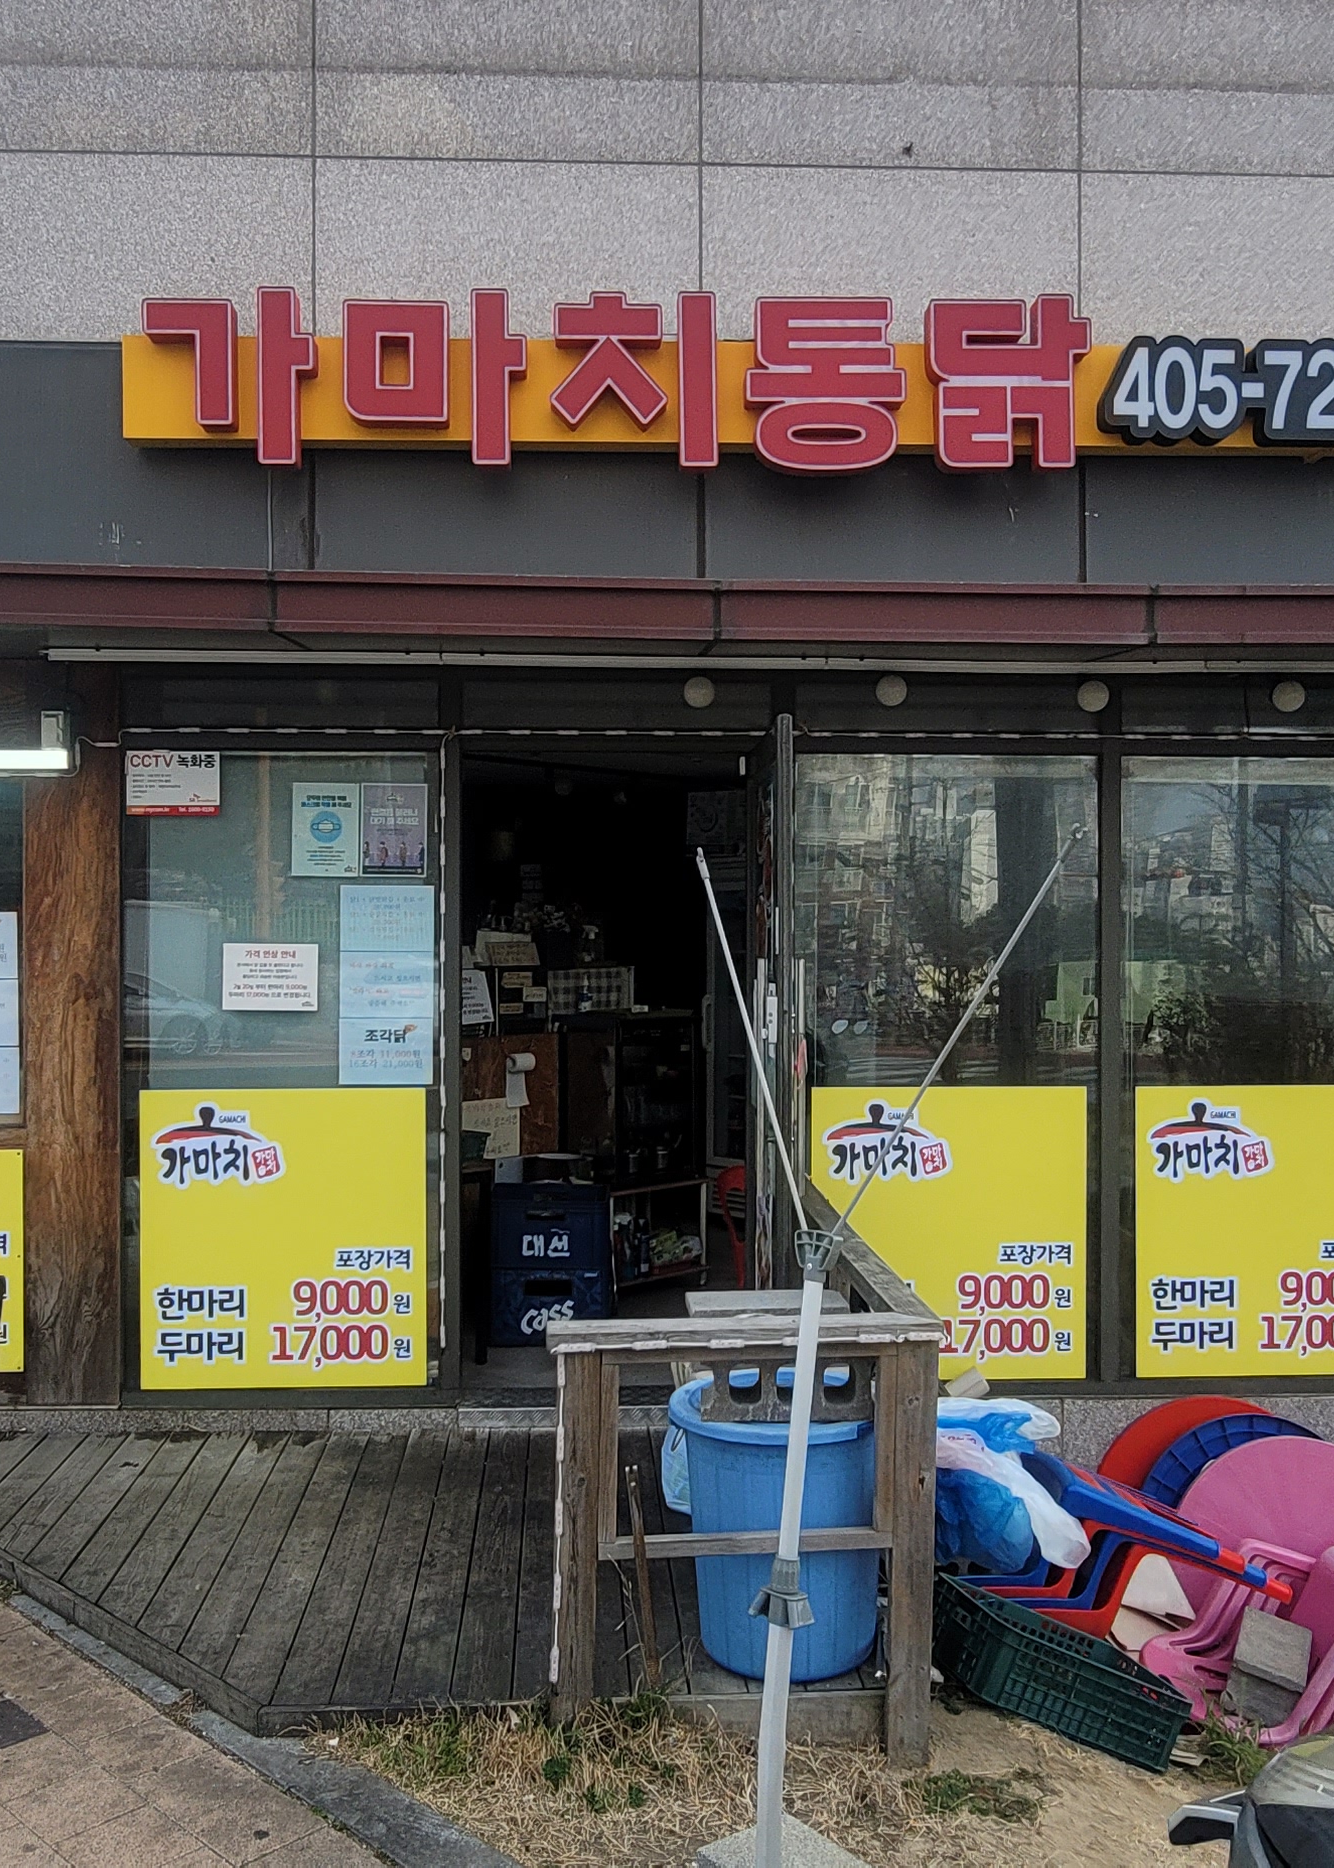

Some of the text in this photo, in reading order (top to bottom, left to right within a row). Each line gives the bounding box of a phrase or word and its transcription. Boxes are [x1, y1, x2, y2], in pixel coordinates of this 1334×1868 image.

[141, 286, 1092, 474] 가마치통닭
[130, 754, 216, 769] CCTV 녹화중
[245, 949, 297, 958] 가격 인상 안내
[364, 1029, 407, 1043] 조각닭
[161, 1139, 250, 1184] 가마치
[832, 1136, 917, 1180] 가마치
[1156, 1134, 1239, 1178] 가마치
[336, 1250, 411, 1270] 포장가격
[522, 1233, 571, 1258] 대선
[1000, 1244, 1072, 1264] 포장가격
[157, 1280, 411, 1323] 한마리 9,000 원
[958, 1274, 1071, 1315] 9,000 원
[1151, 1278, 1234, 1310] 한마리
[157, 1325, 411, 1367] 두마리 17,000 원
[1054, 1331, 1071, 1351] 원
[1152, 1321, 1233, 1351] 두마리
